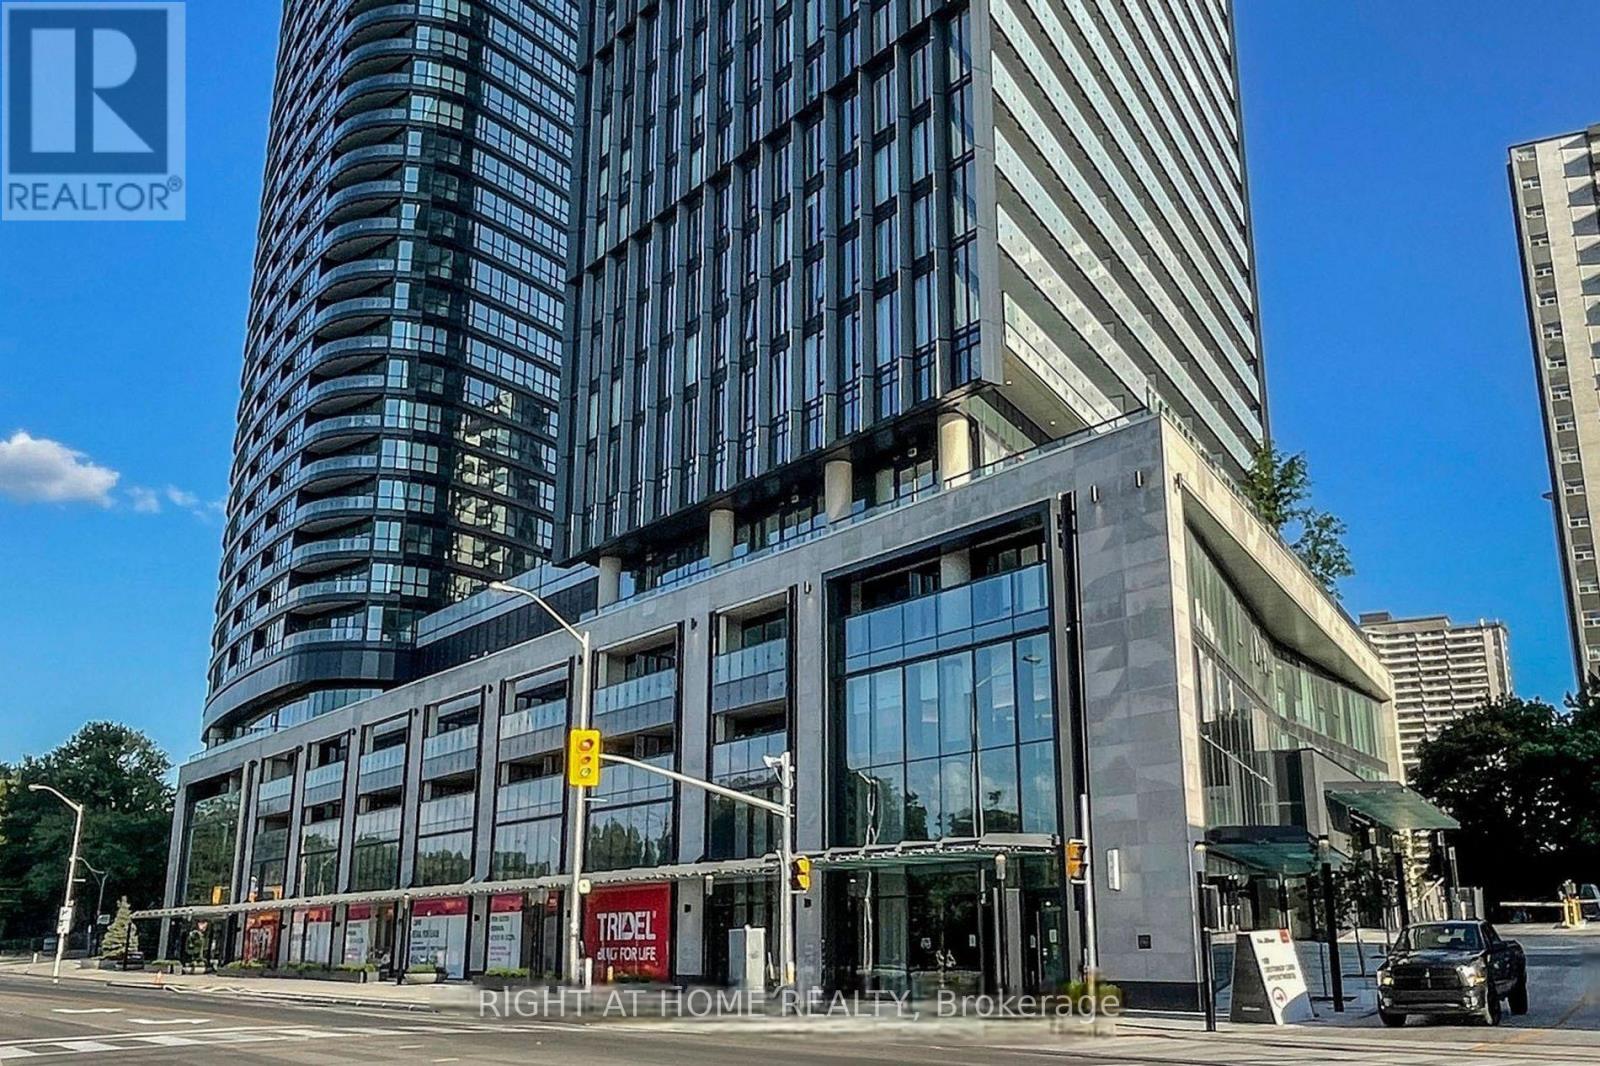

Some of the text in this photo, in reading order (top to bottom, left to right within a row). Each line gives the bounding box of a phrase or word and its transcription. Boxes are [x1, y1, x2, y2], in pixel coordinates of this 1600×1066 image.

[597, 911, 656, 941] TRIDEL
[620, 946, 638, 961] FOR
[638, 946, 656, 961] LIFE
